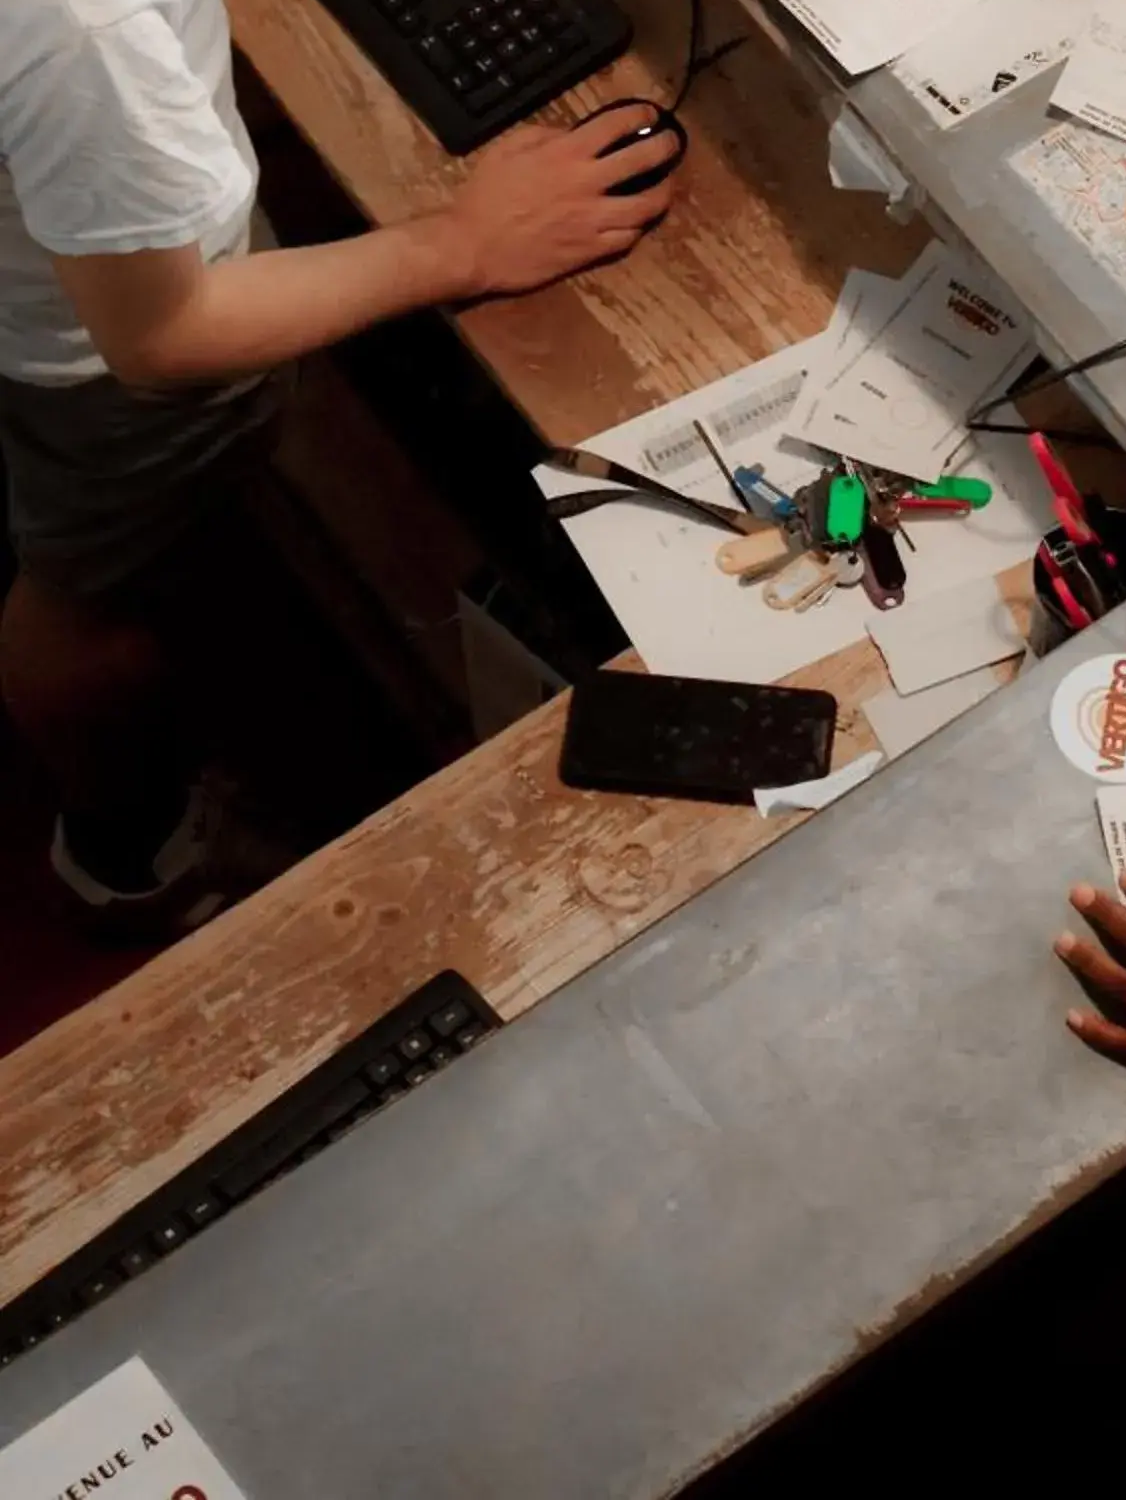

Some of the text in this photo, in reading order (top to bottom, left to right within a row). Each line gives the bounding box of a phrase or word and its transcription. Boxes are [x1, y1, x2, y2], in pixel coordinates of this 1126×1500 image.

[948, 277, 1003, 319] WELCOME
[52, 1418, 174, 1500] ENUE AU
